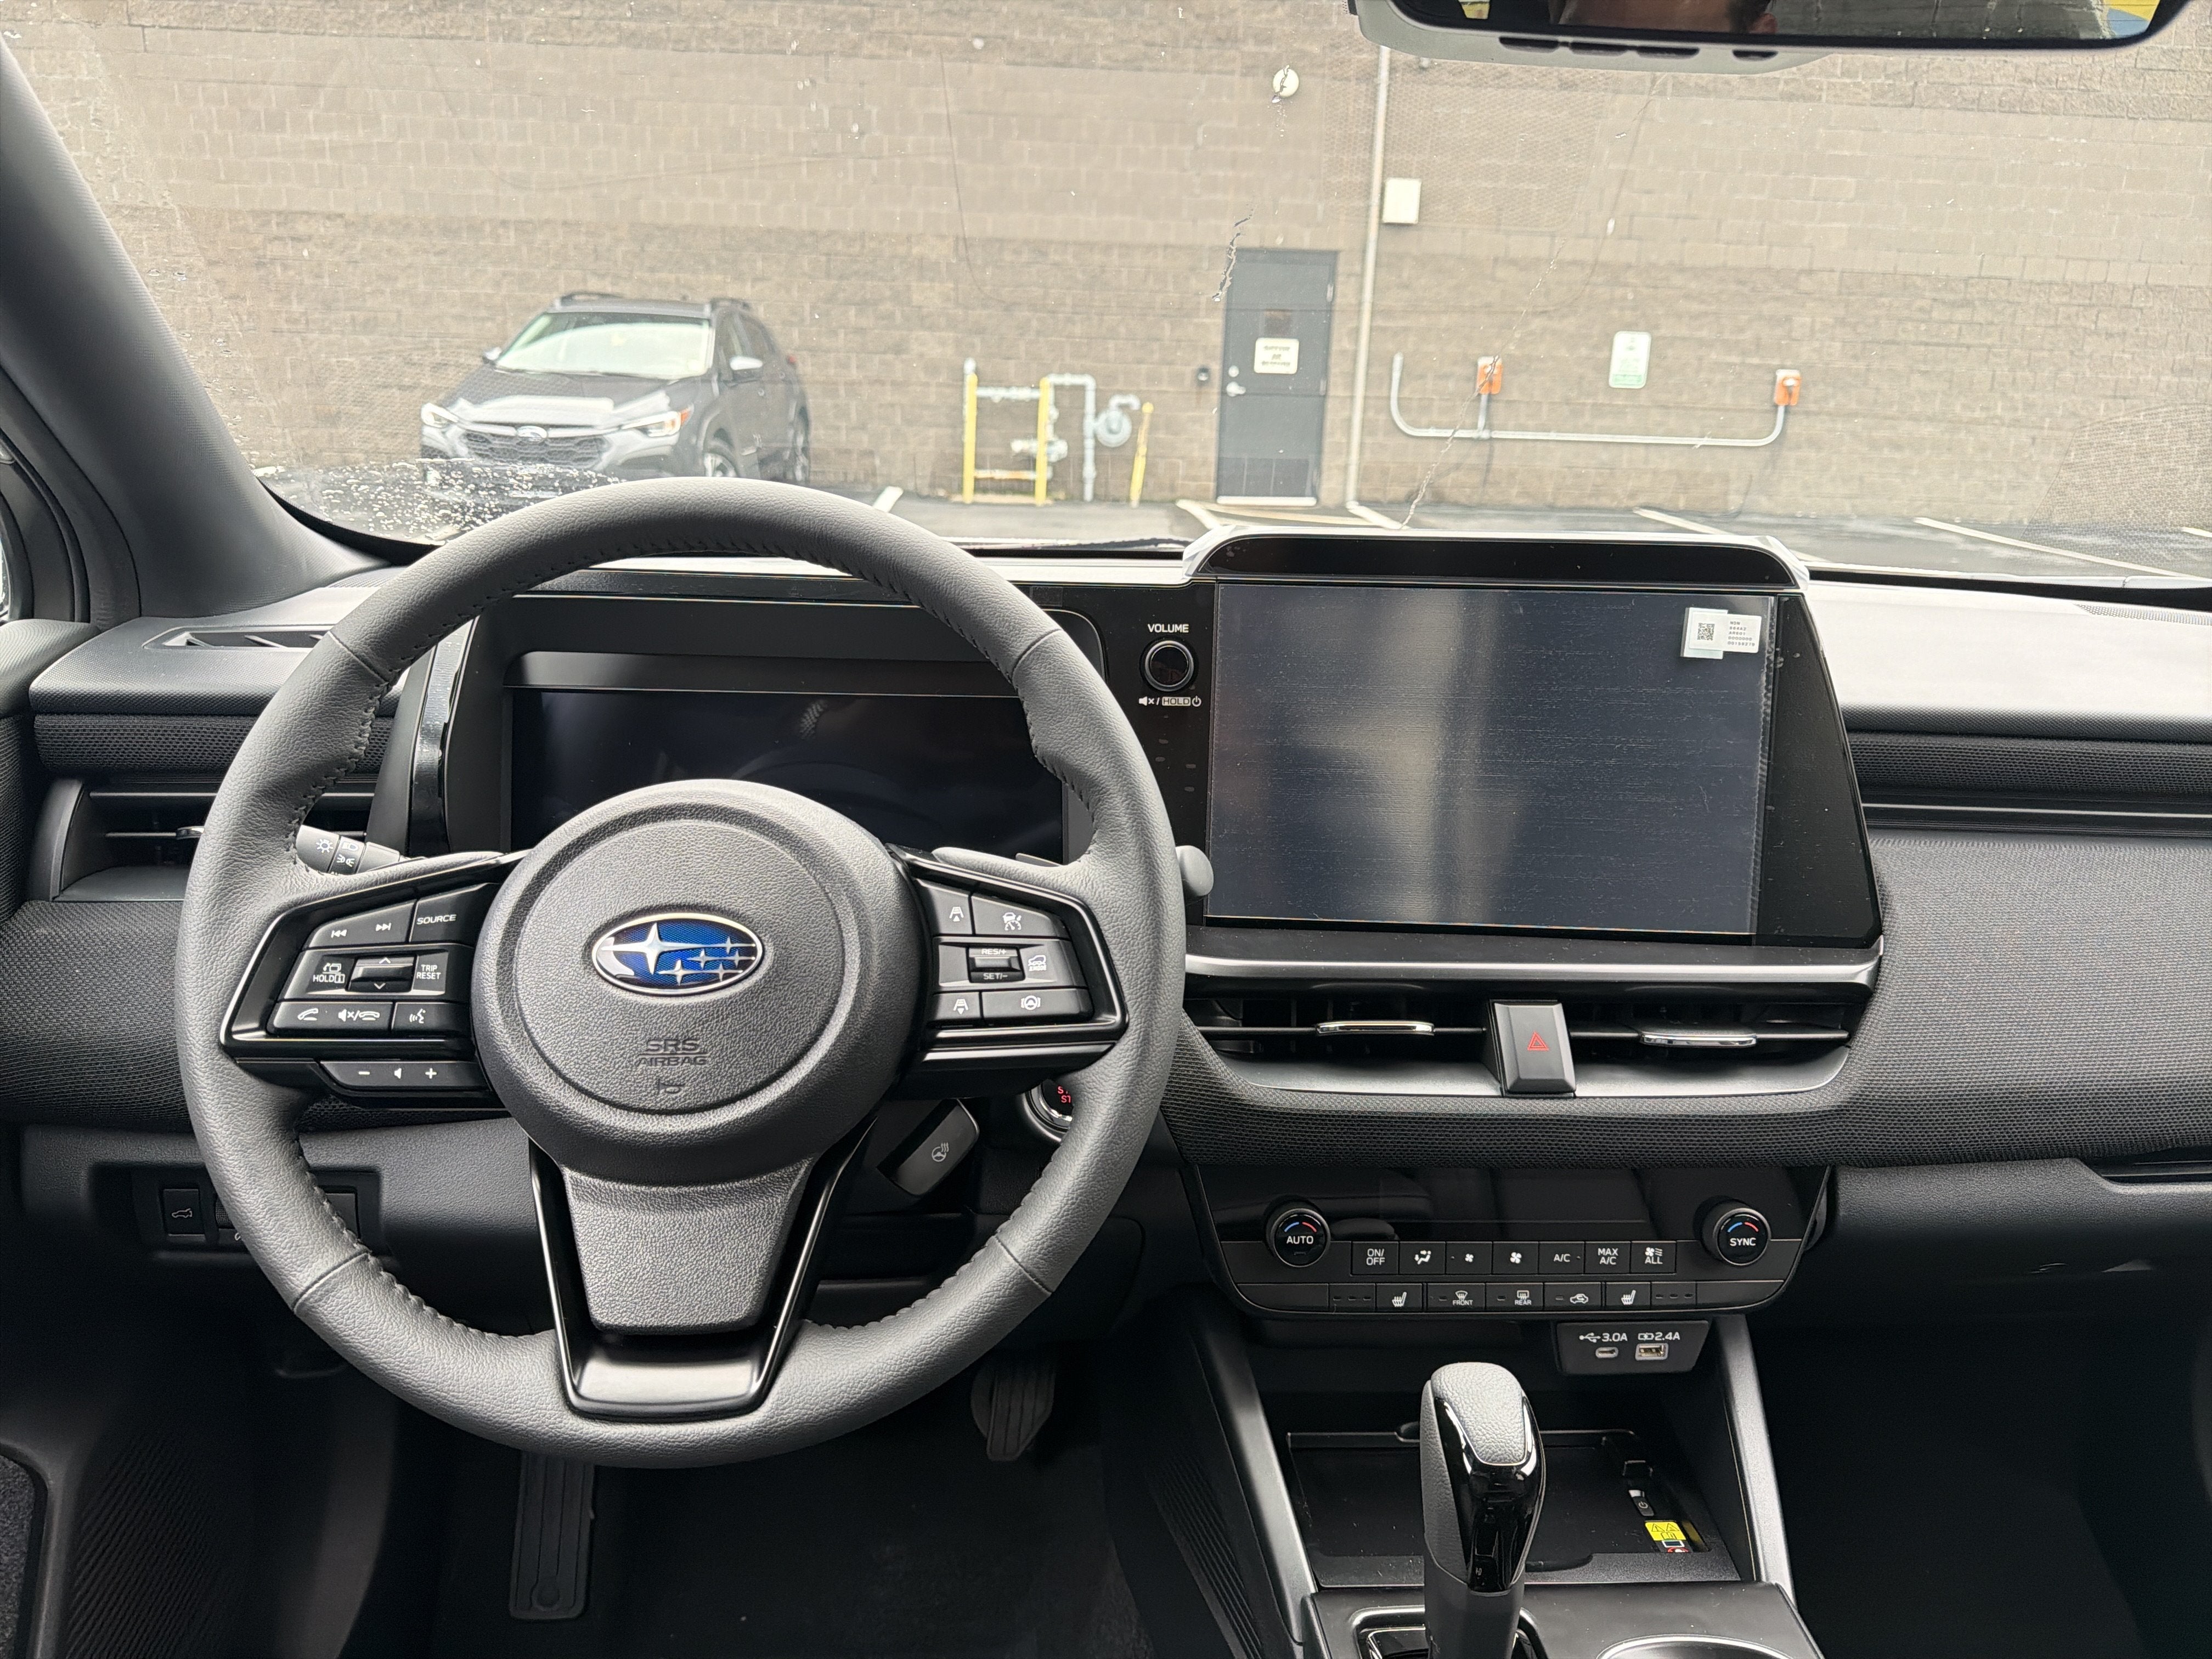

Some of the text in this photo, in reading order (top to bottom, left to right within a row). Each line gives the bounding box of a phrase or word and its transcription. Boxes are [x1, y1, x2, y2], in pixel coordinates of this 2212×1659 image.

[1147, 624, 1189, 633] VOLUME
[417, 915, 456, 924] SOURCE
[421, 964, 437, 973] TRIP
[645, 1038, 701, 1053] SRS
[637, 1056, 708, 1066] AIRBAG
[1286, 1235, 1313, 1245] AUTO
[1730, 1237, 1756, 1247] SYNC
[1367, 1249, 1385, 1257] ON/
[1598, 1248, 1618, 1256] MAX
[1366, 1257, 1385, 1266] OFF
[1554, 1254, 1571, 1262] A/C
[1599, 1257, 1617, 1265] A/C
[1645, 1256, 1663, 1265] ALL
[1601, 1333, 1628, 1342] 3.0A
[1655, 1331, 1680, 1341] 2.4A
